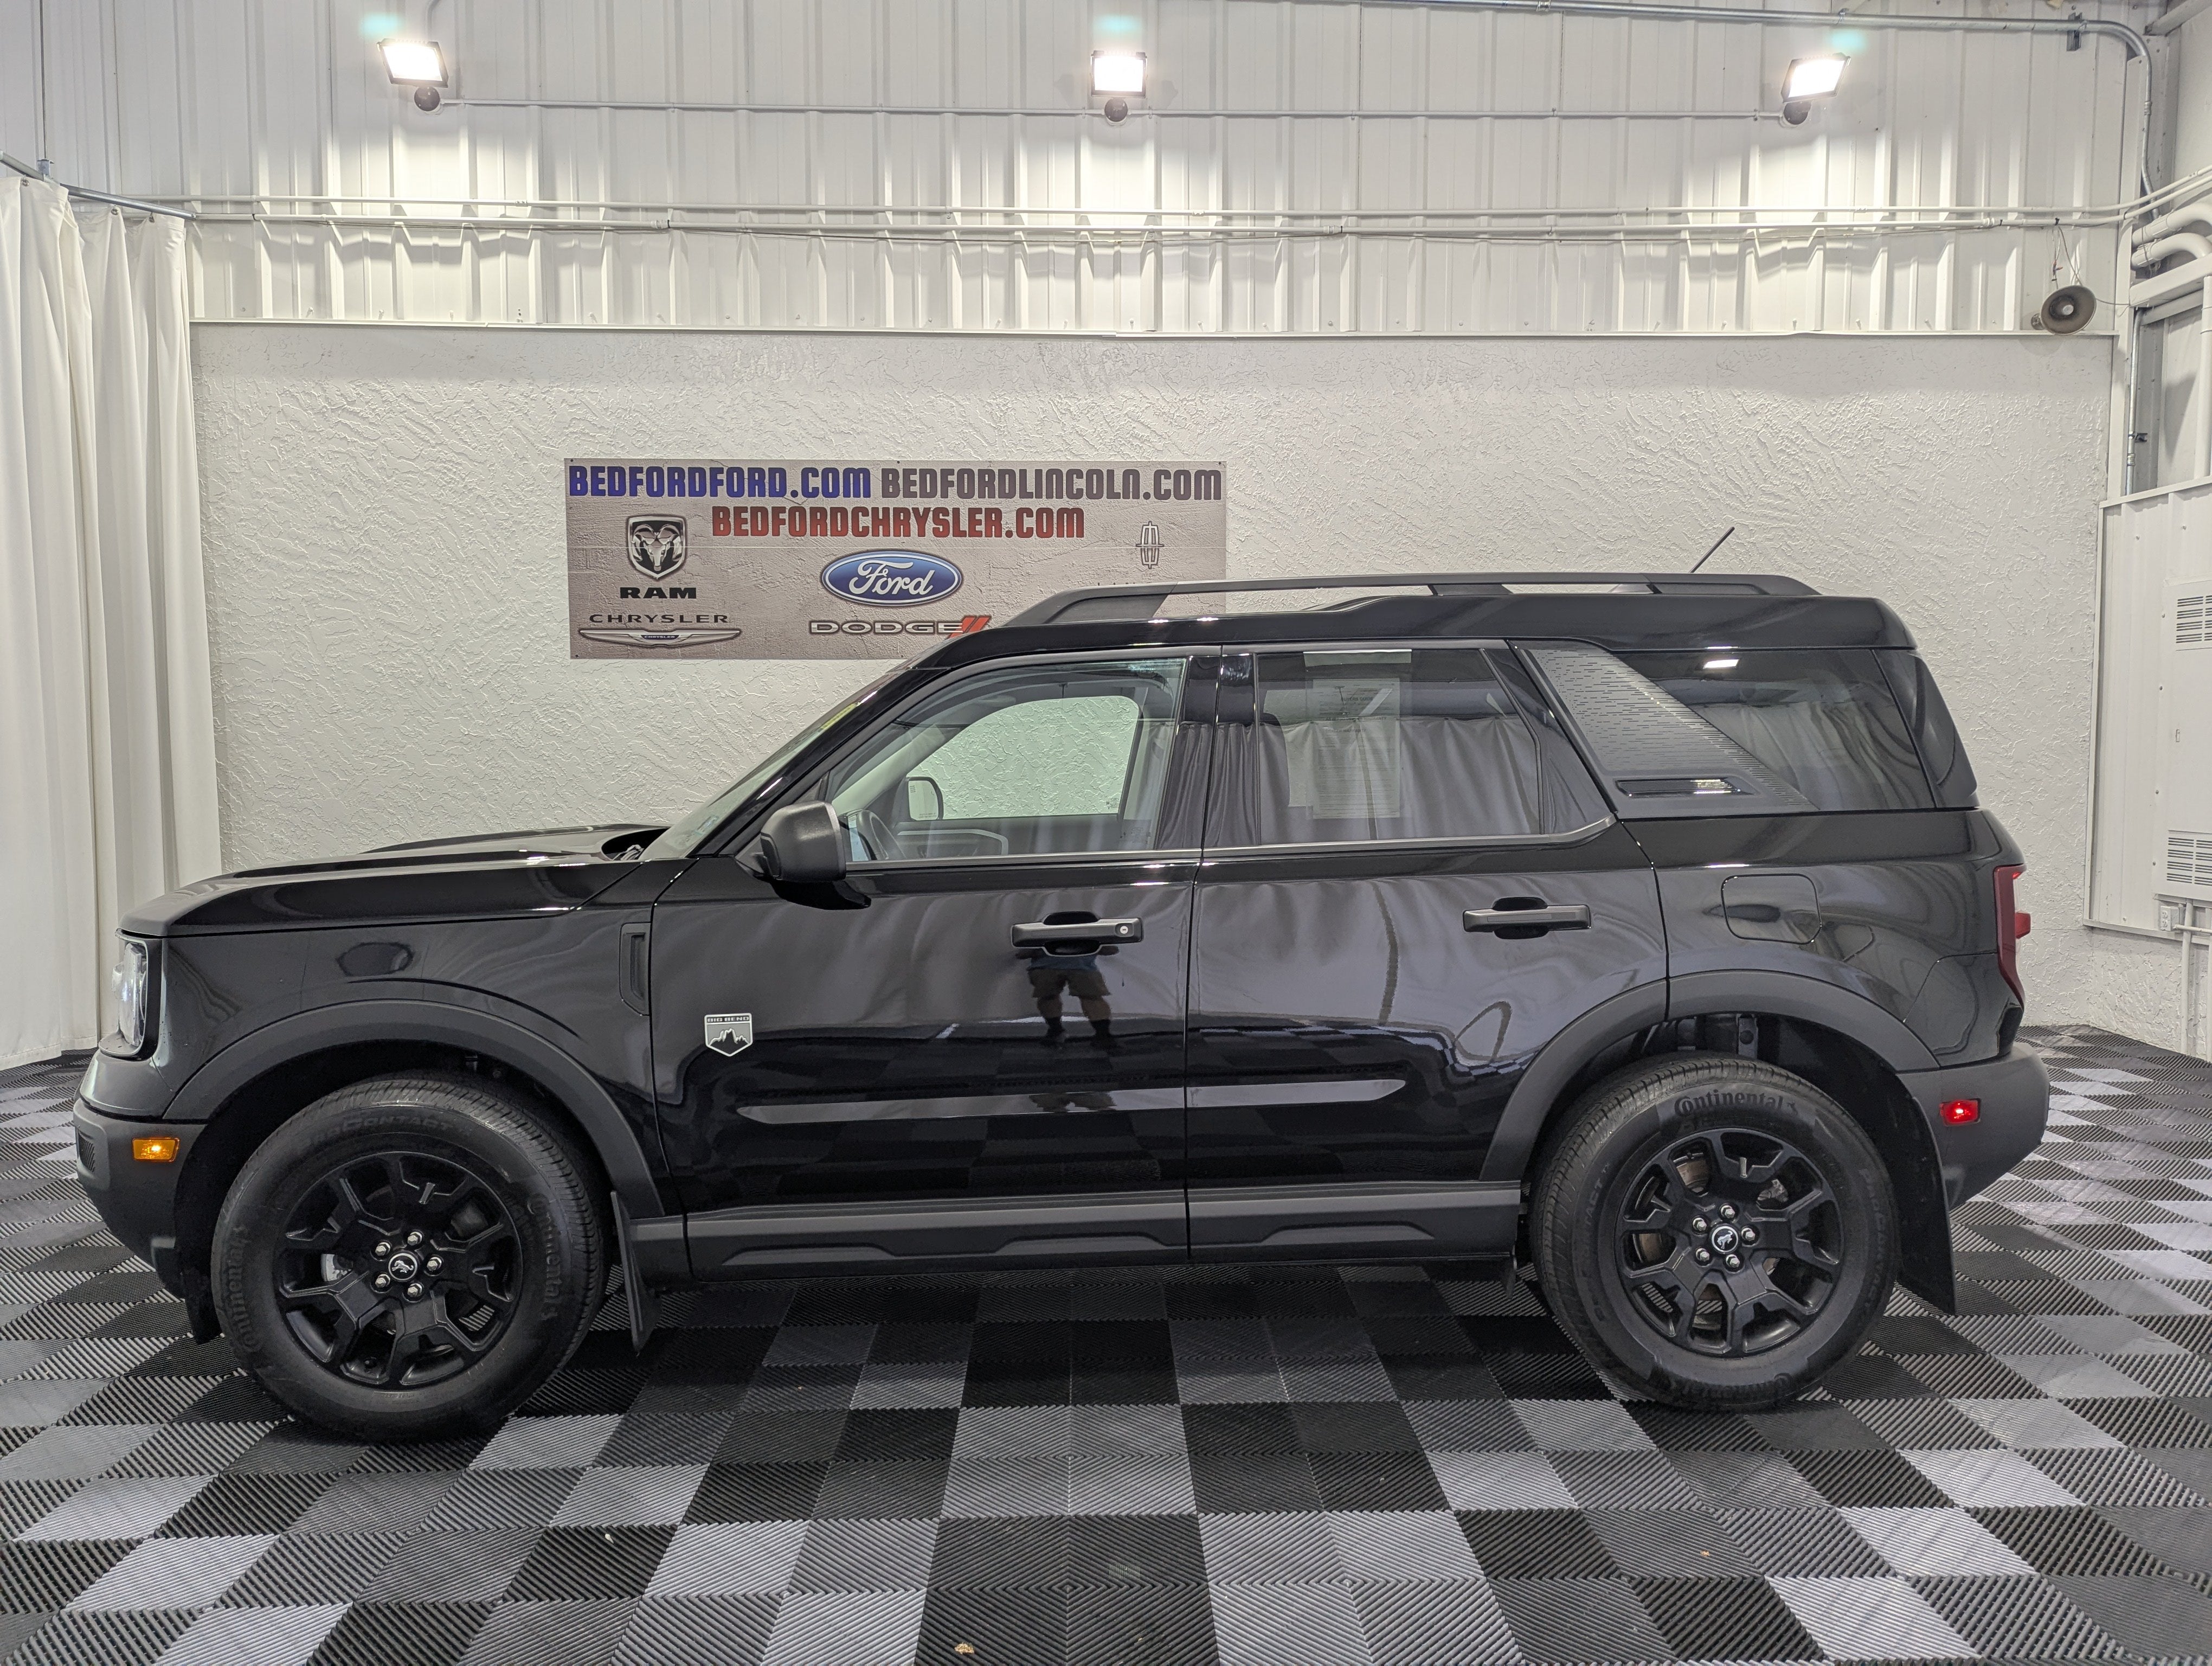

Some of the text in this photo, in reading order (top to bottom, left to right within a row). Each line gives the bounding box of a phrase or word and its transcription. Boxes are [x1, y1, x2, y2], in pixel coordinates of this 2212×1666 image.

[569, 465, 1221, 500] BEDFORDFORD.COM BEDFORDLINCOLN.COM
[711, 506, 1084, 539] BEDFORDCHRYSLER.COM
[848, 560, 935, 595] Ford
[620, 587, 697, 599] RAM
[589, 614, 728, 624] CHRYSLER
[811, 621, 964, 634] DODGE
[1674, 1089, 1783, 1116] Continental
